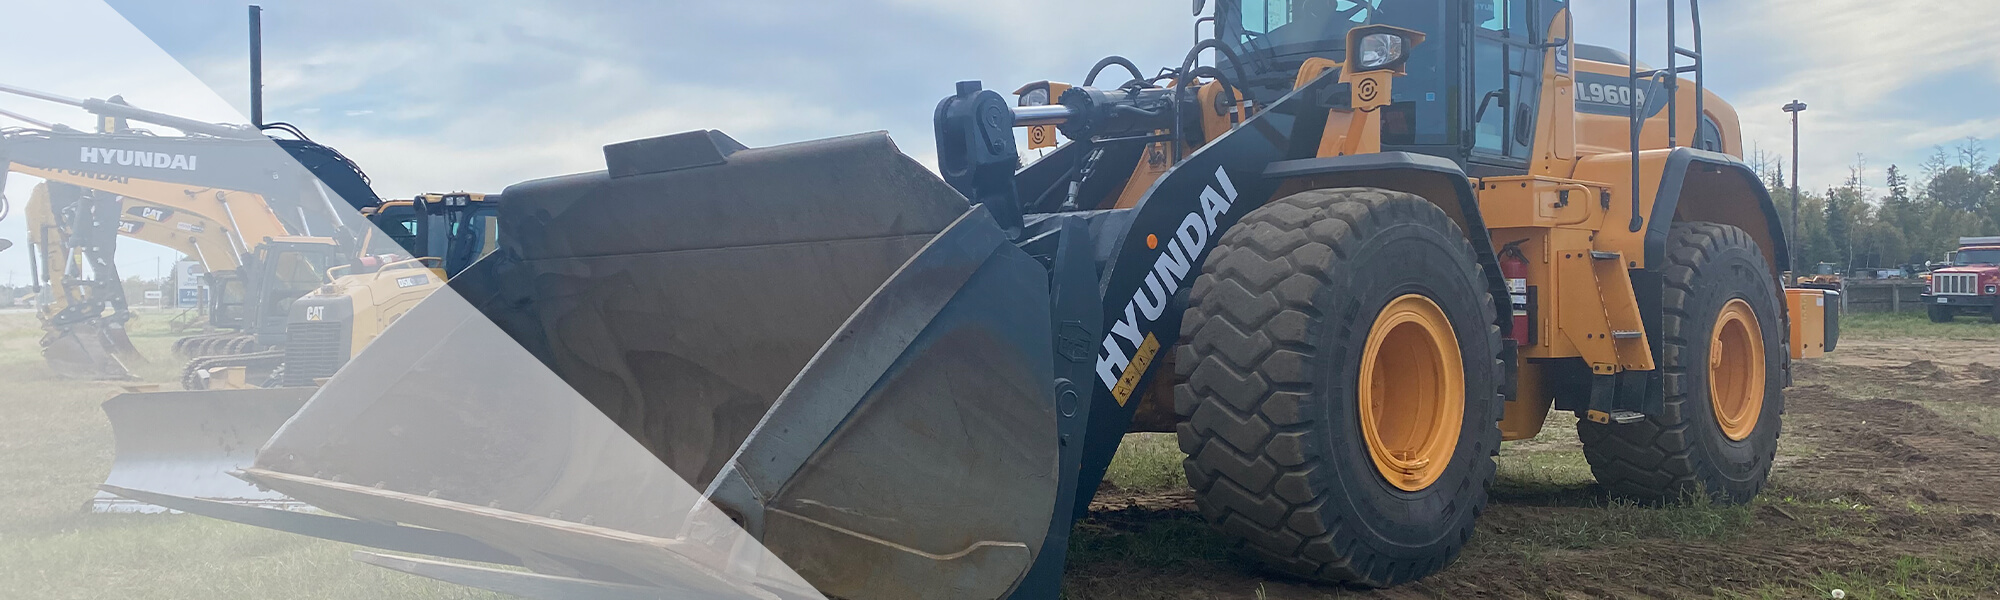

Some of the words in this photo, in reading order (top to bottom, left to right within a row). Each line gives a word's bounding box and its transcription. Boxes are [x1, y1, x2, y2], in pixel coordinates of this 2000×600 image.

[80, 147, 197, 171] HYUNDAI
[142, 207, 163, 221] CAT
[1095, 165, 1239, 392] HYUNDAI
[306, 306, 325, 321] CAT
